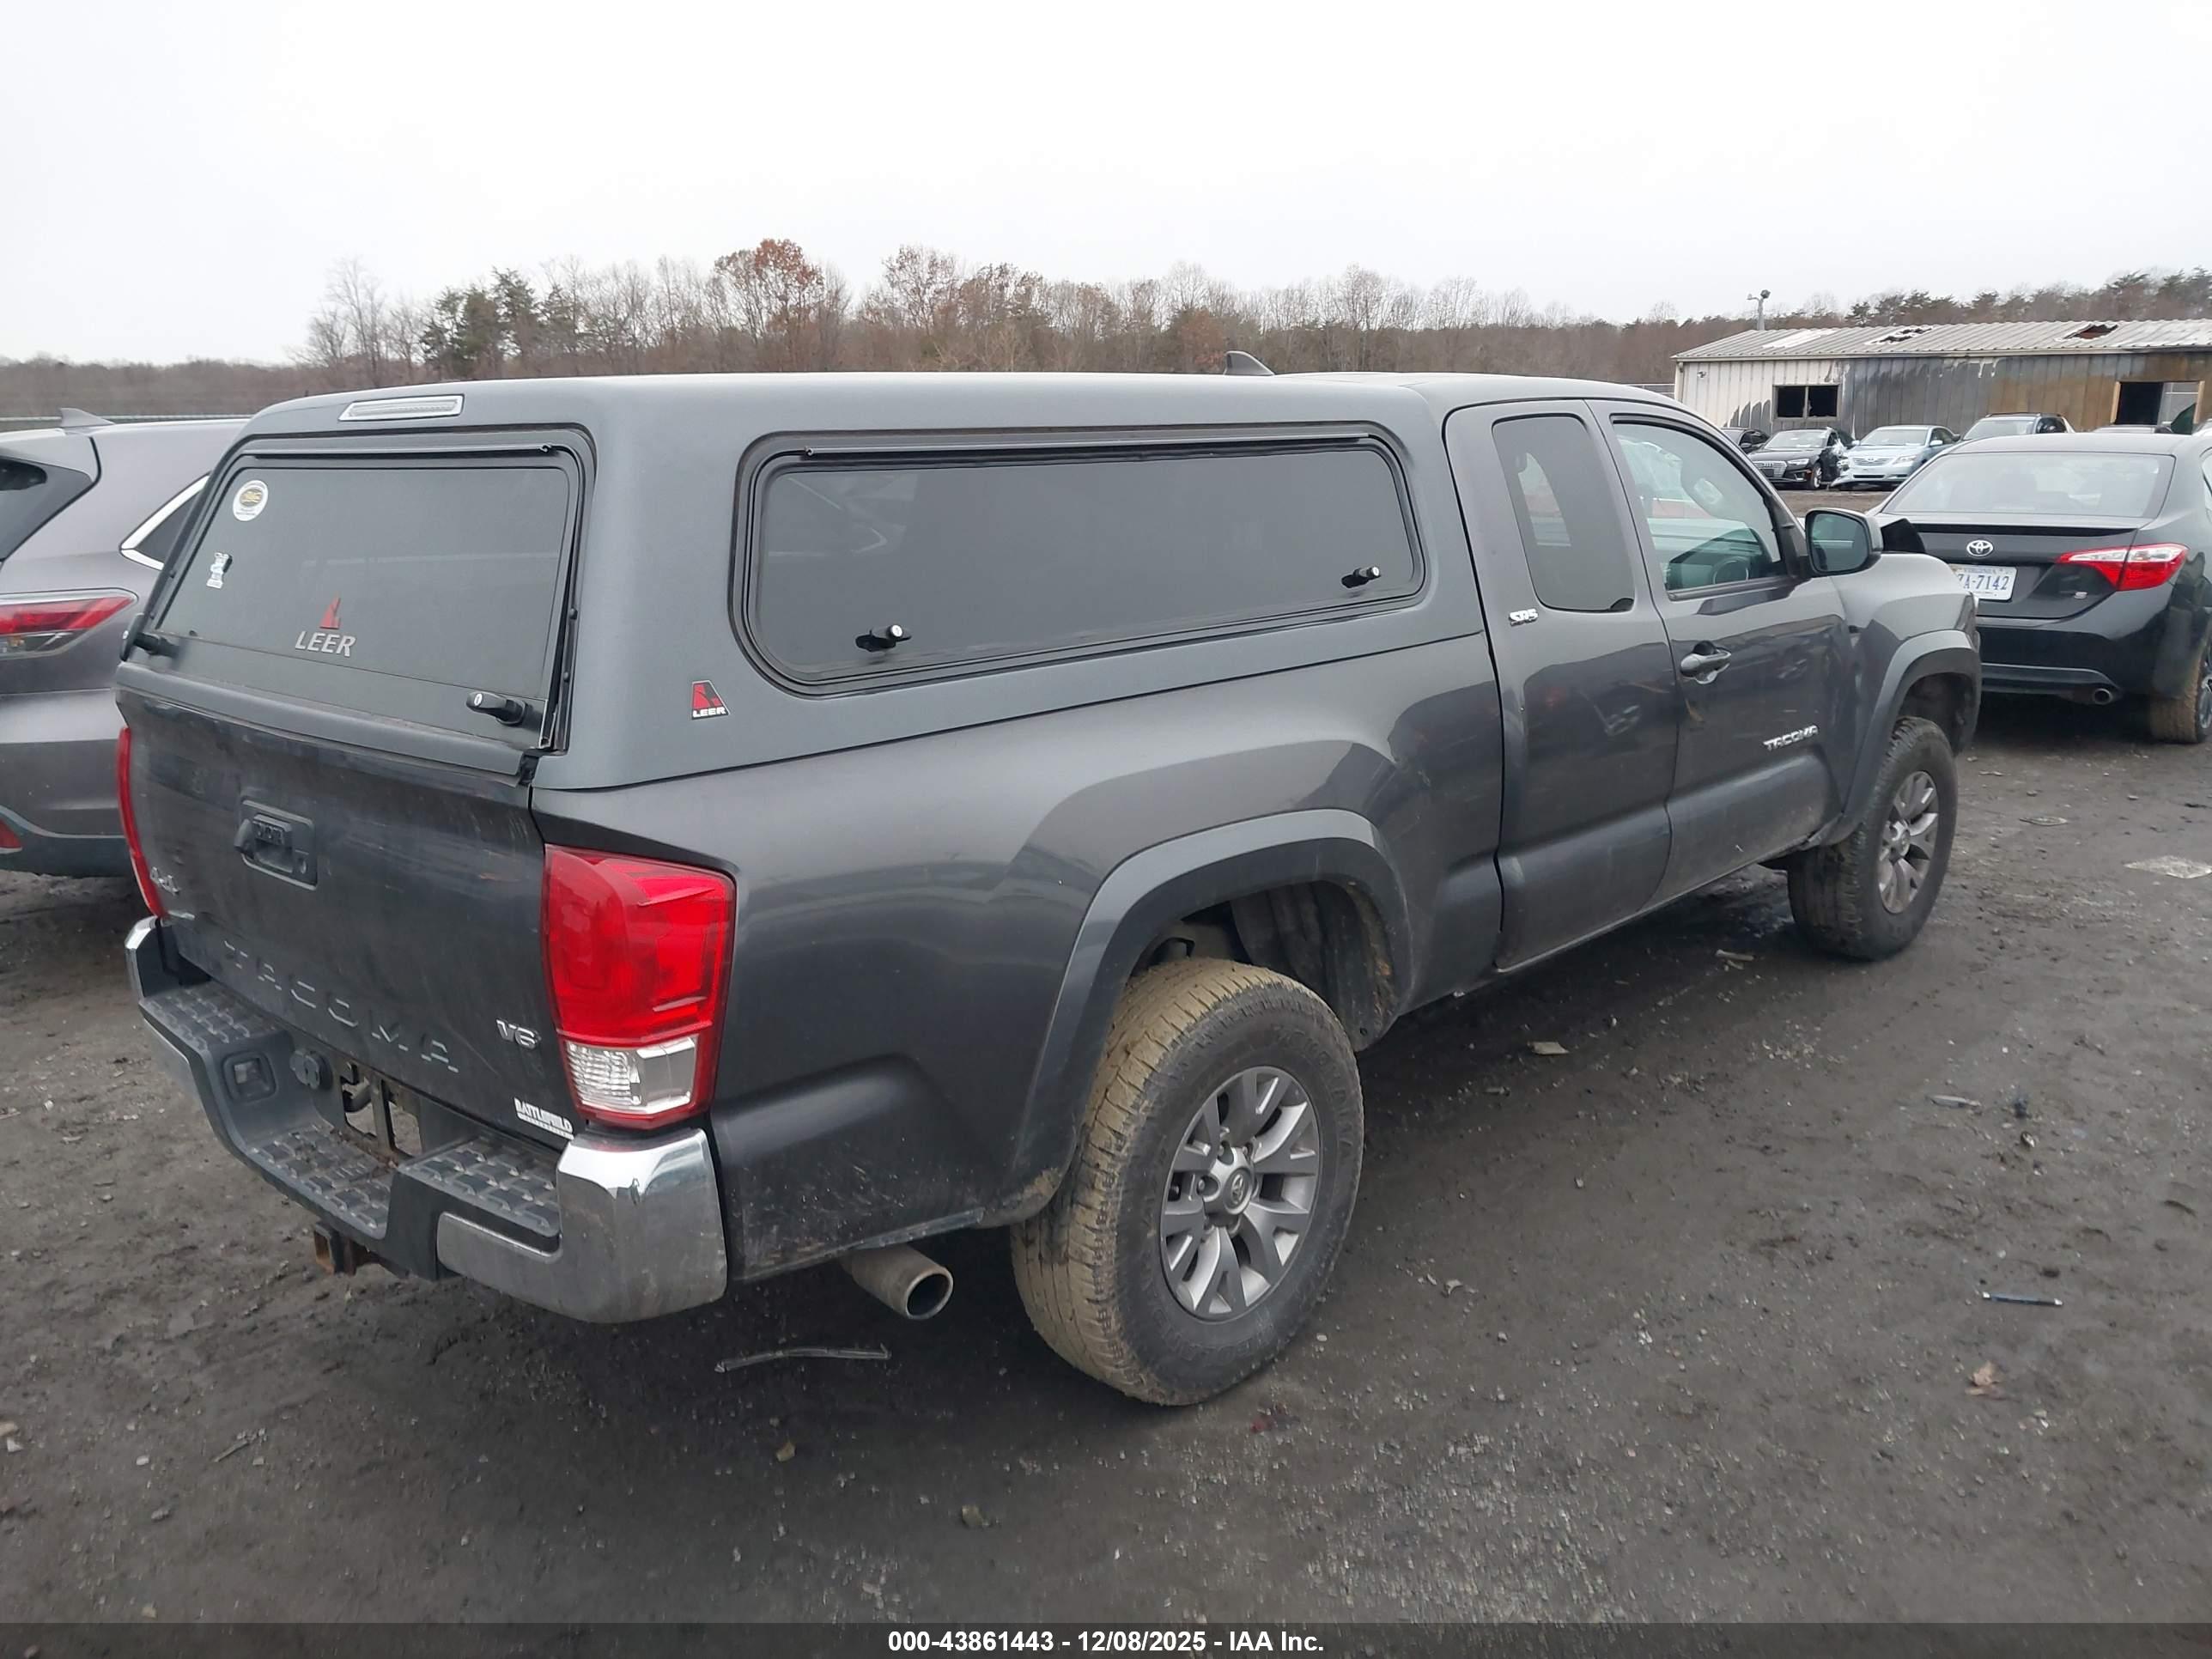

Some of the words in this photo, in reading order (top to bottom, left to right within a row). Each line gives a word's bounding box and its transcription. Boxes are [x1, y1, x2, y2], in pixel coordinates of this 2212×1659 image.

[295, 629, 356, 658] LEER
[692, 706, 726, 718] LEER
[1762, 724, 1820, 752] TACOMA
[222, 939, 461, 1075] TACOMA
[495, 1018, 540, 1051] V6
